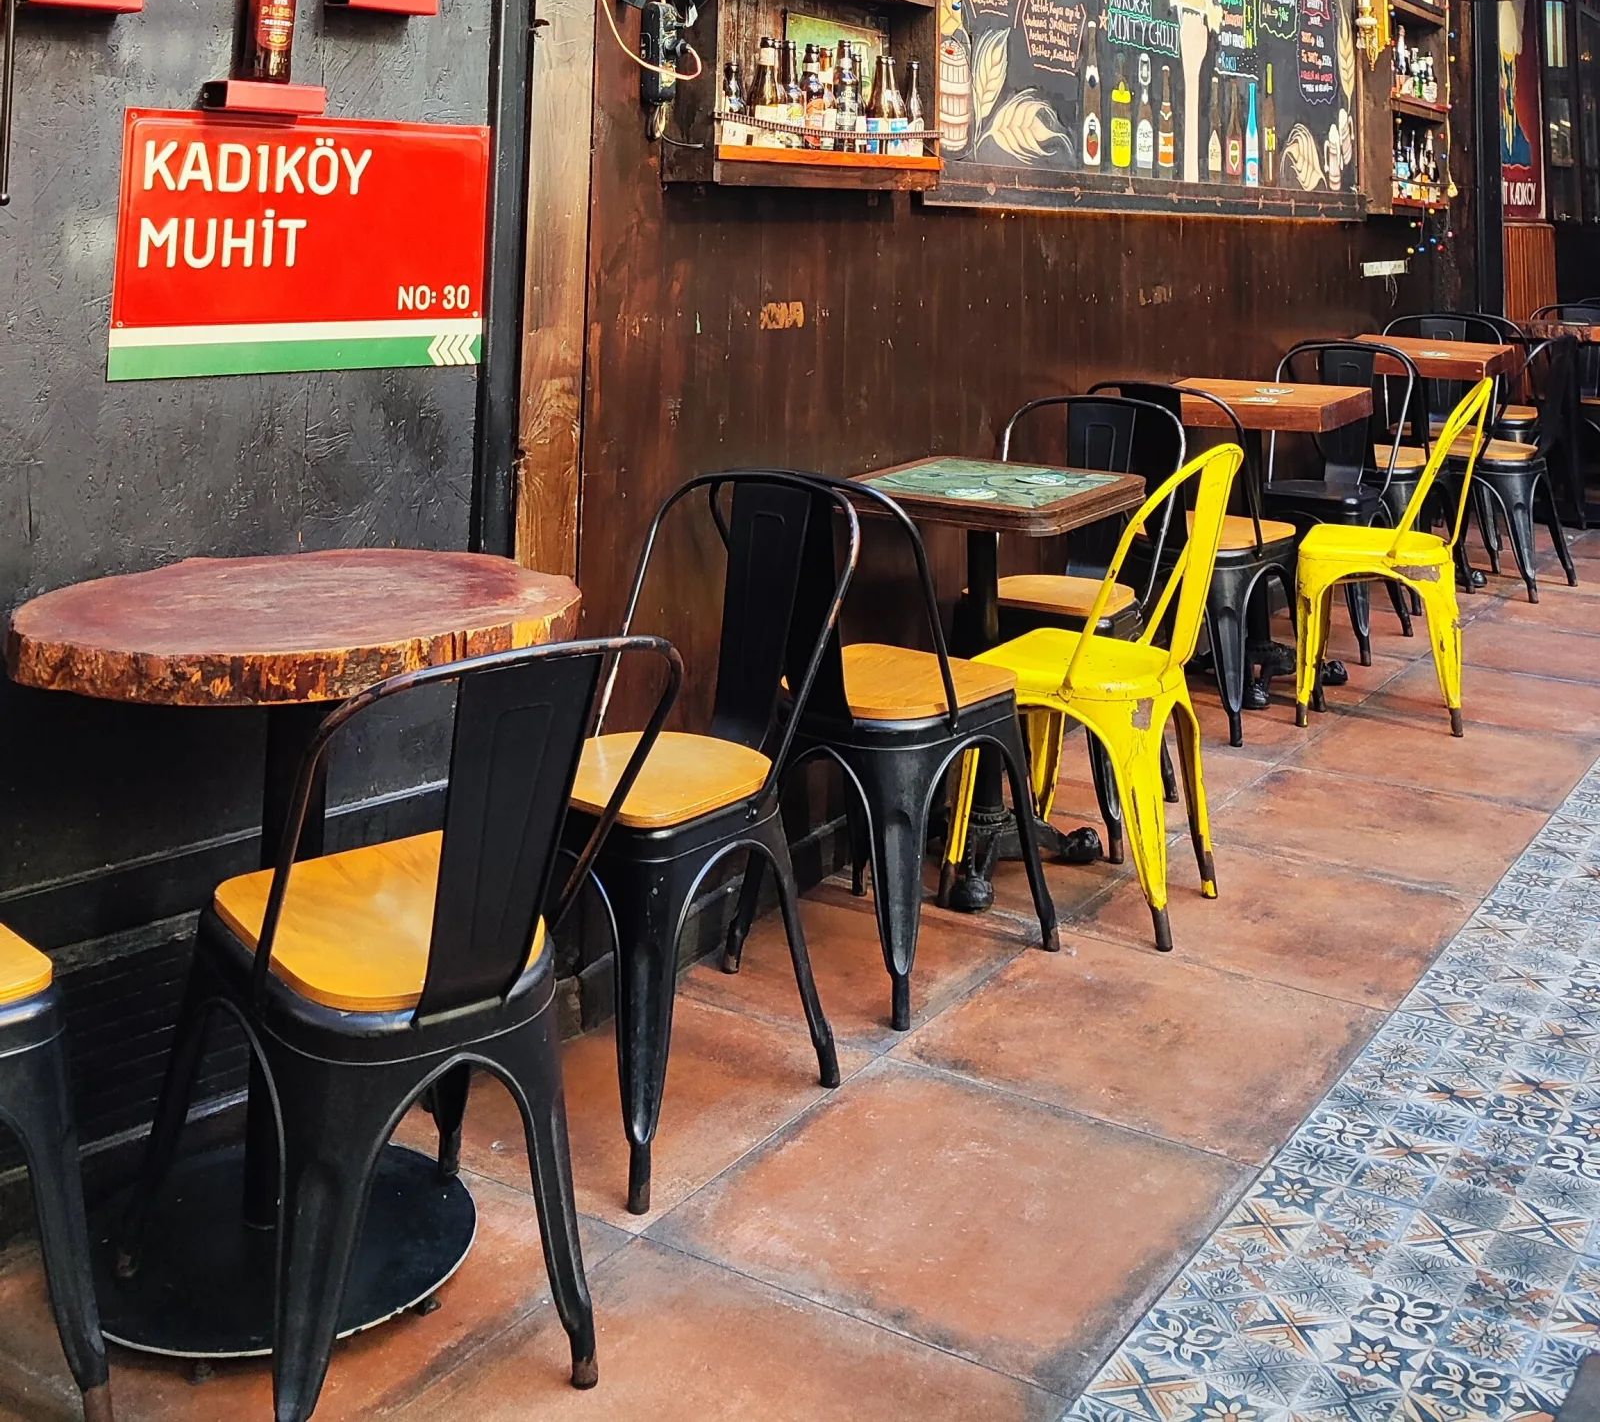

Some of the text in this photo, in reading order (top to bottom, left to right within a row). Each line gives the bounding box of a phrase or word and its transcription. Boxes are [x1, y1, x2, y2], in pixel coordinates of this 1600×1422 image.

[143, 138, 373, 196] KADIKÖY
[138, 208, 307, 269] MUHİT
[398, 285, 470, 310] NO: 30
